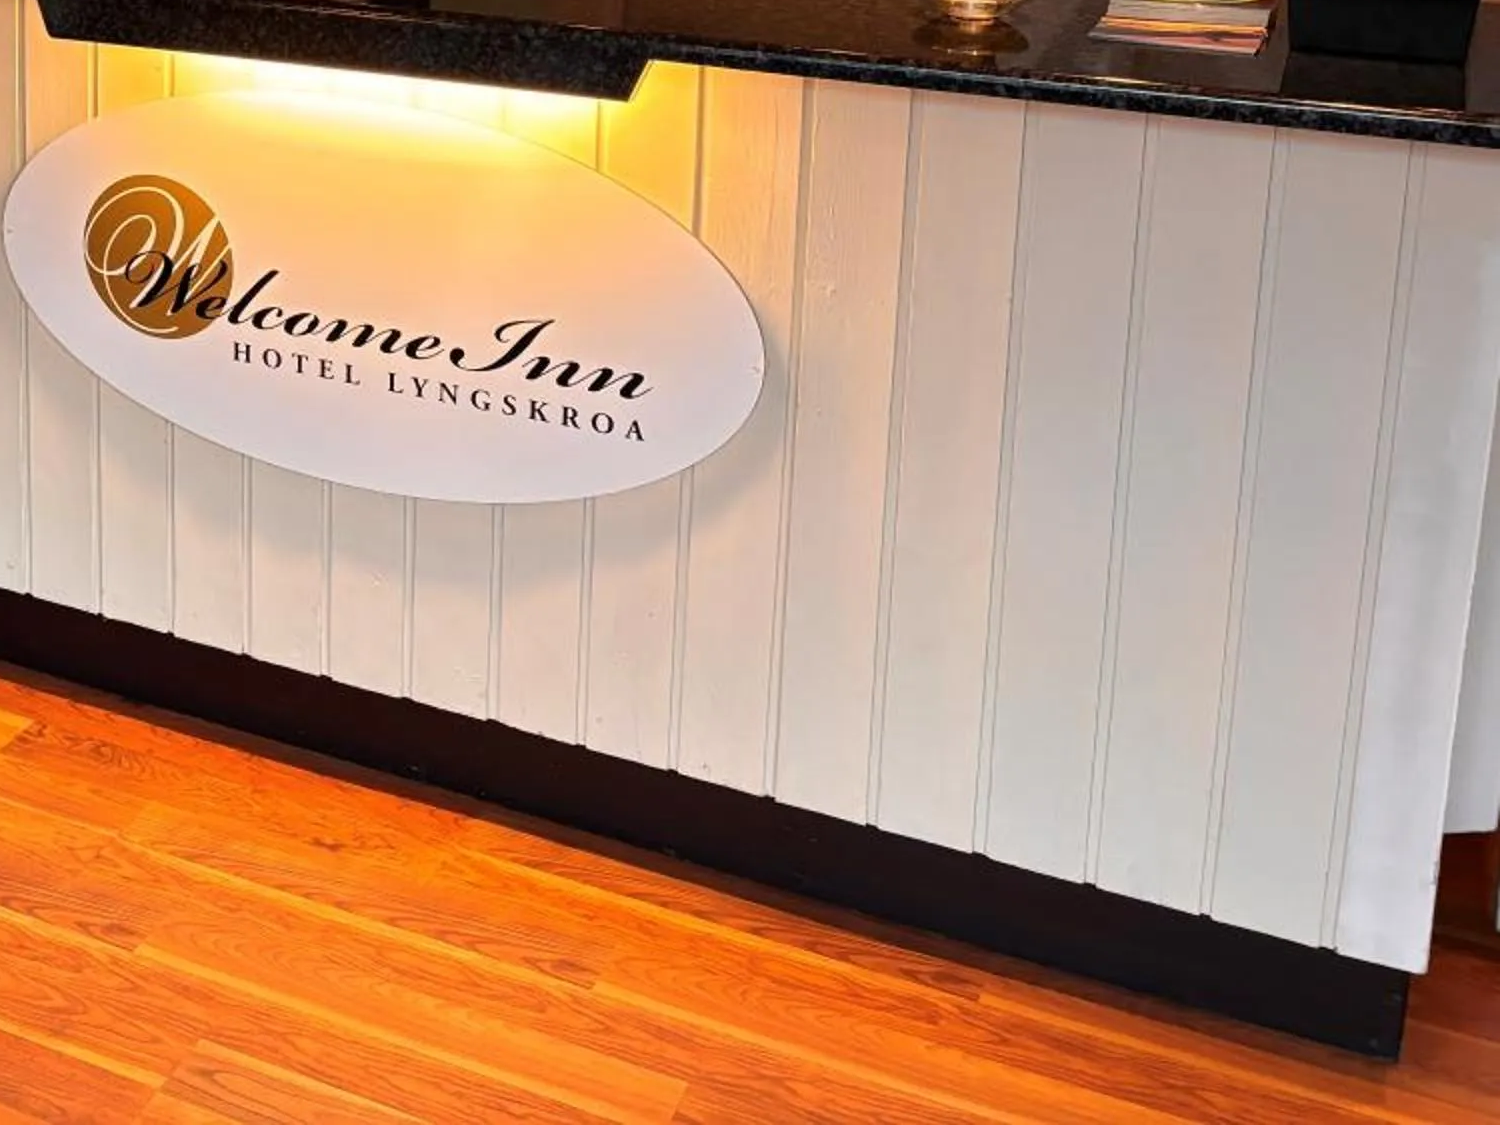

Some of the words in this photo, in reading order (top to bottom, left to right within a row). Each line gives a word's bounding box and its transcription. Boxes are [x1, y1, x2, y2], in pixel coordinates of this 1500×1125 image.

[125, 250, 445, 360] Welcome
[449, 318, 653, 400] Inn
[233, 342, 360, 386] HOTEL
[387, 372, 645, 442] LYNGSKROA
